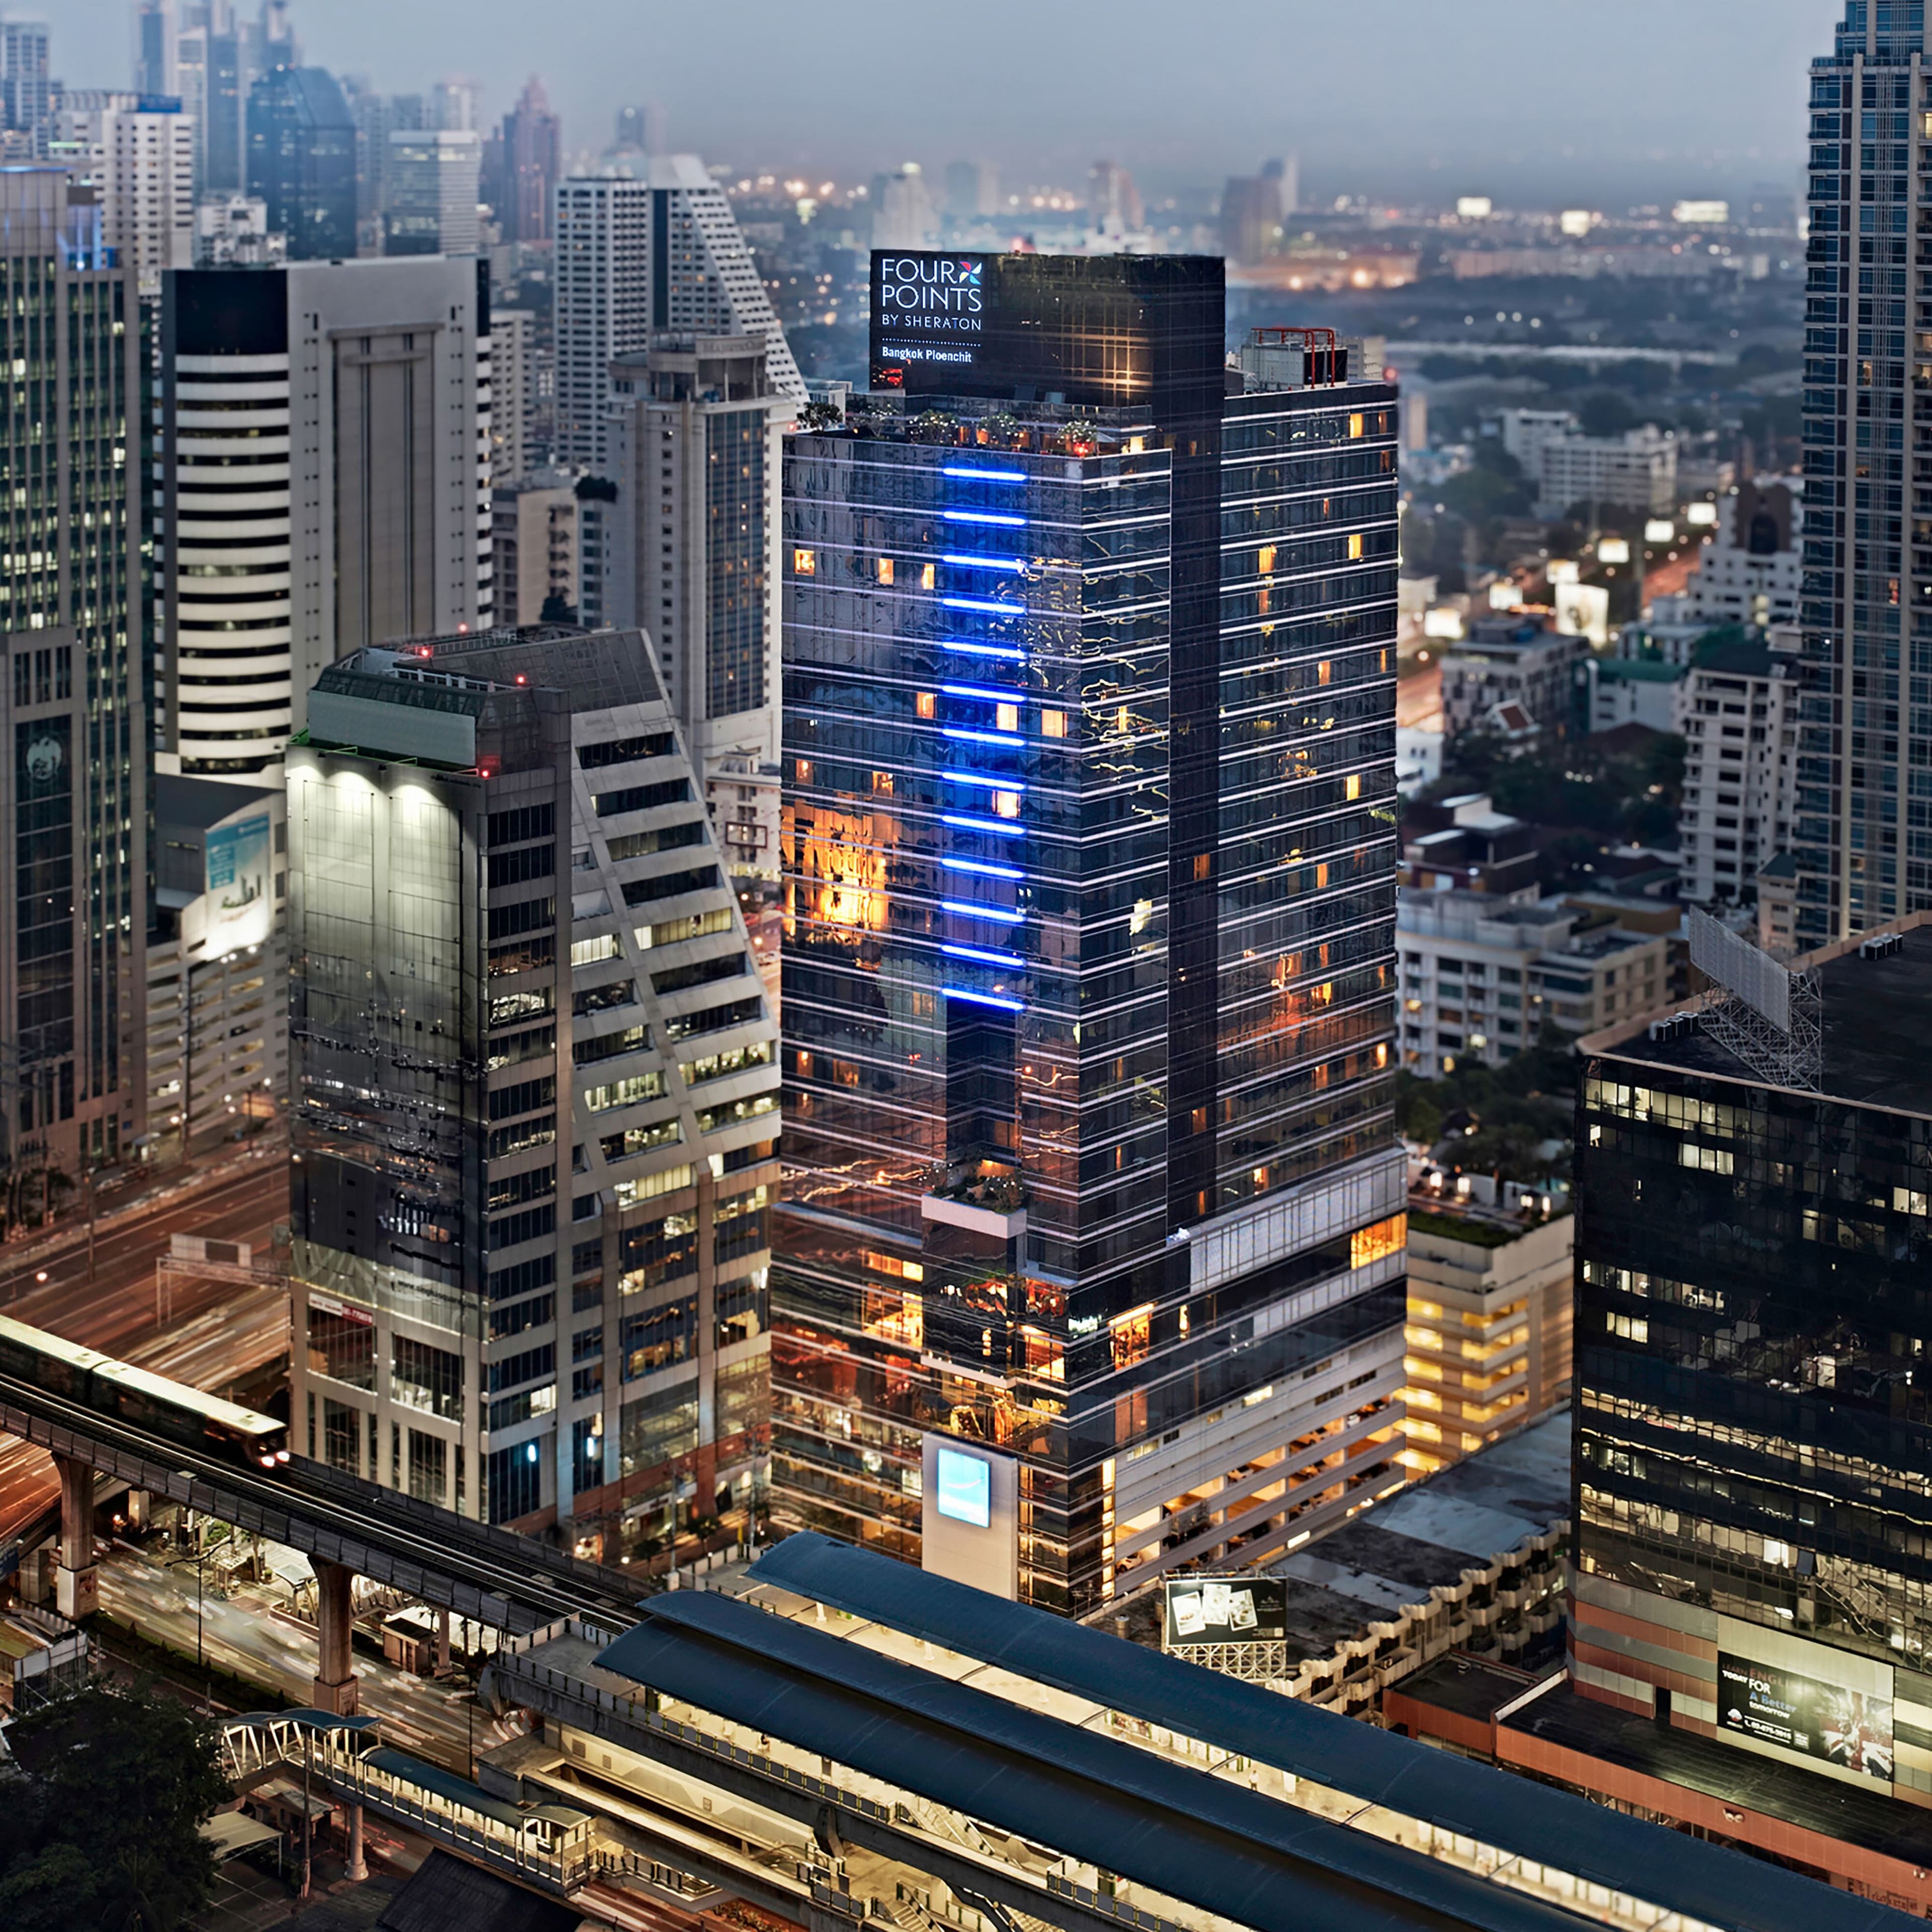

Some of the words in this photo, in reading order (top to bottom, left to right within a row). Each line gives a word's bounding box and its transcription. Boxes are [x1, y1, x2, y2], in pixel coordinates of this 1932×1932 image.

[882, 259, 957, 284] FOUR
[882, 285, 982, 312] POINTS
[882, 314, 899, 327] BY
[905, 315, 982, 330] SHERATON
[882, 346, 923, 361] Bangkok
[926, 350, 972, 363] Ploenchit
[1722, 1670, 1748, 1683] TODAY
[1748, 1678, 1771, 1695] FOR
[1748, 1701, 1791, 1719] tomorrow
[1749, 1692, 1758, 1702] A
[1761, 1695, 1797, 1713] Better
